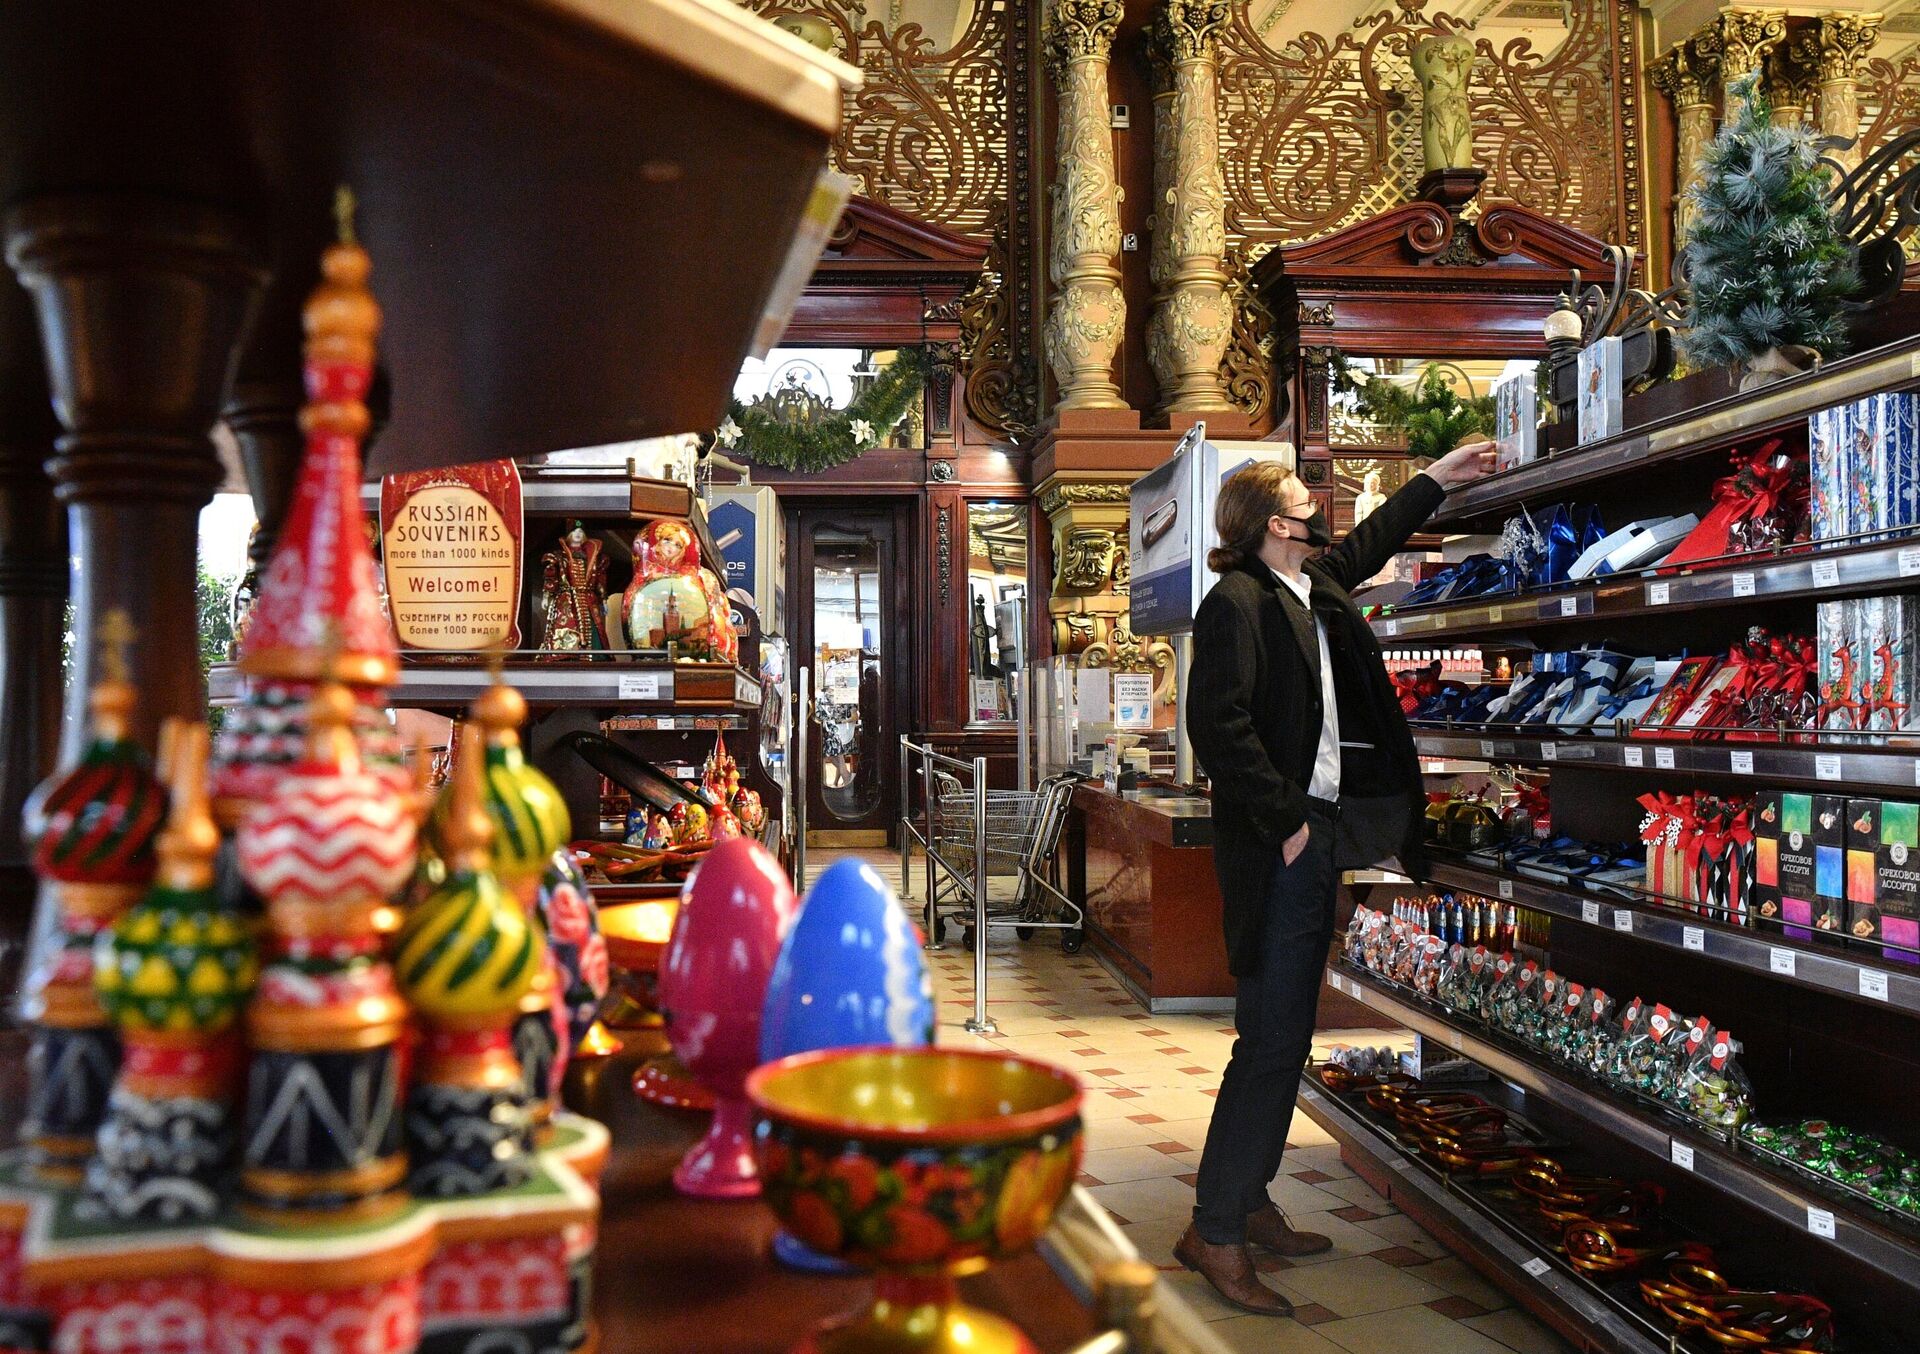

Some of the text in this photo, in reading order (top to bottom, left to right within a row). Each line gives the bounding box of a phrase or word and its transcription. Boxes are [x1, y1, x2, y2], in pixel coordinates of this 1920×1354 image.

[409, 505, 488, 522] RUSSIAN
[396, 525, 501, 542] SOUVENIRS
[390, 548, 511, 558] more than 1000 kinds
[408, 576, 499, 593] Welcome!
[399, 613, 509, 623] СУВЕНИРЫ ИЗ РОССИИ
[409, 625, 500, 636] более 1000 видов
[1780, 853, 1812, 865] ОРЕХОВОЕ
[1782, 863, 1810, 876] АССОРТИ
[1878, 868, 1920, 881] ОРЕХОВОЕ
[1881, 879, 1918, 893] АССОРТИ
